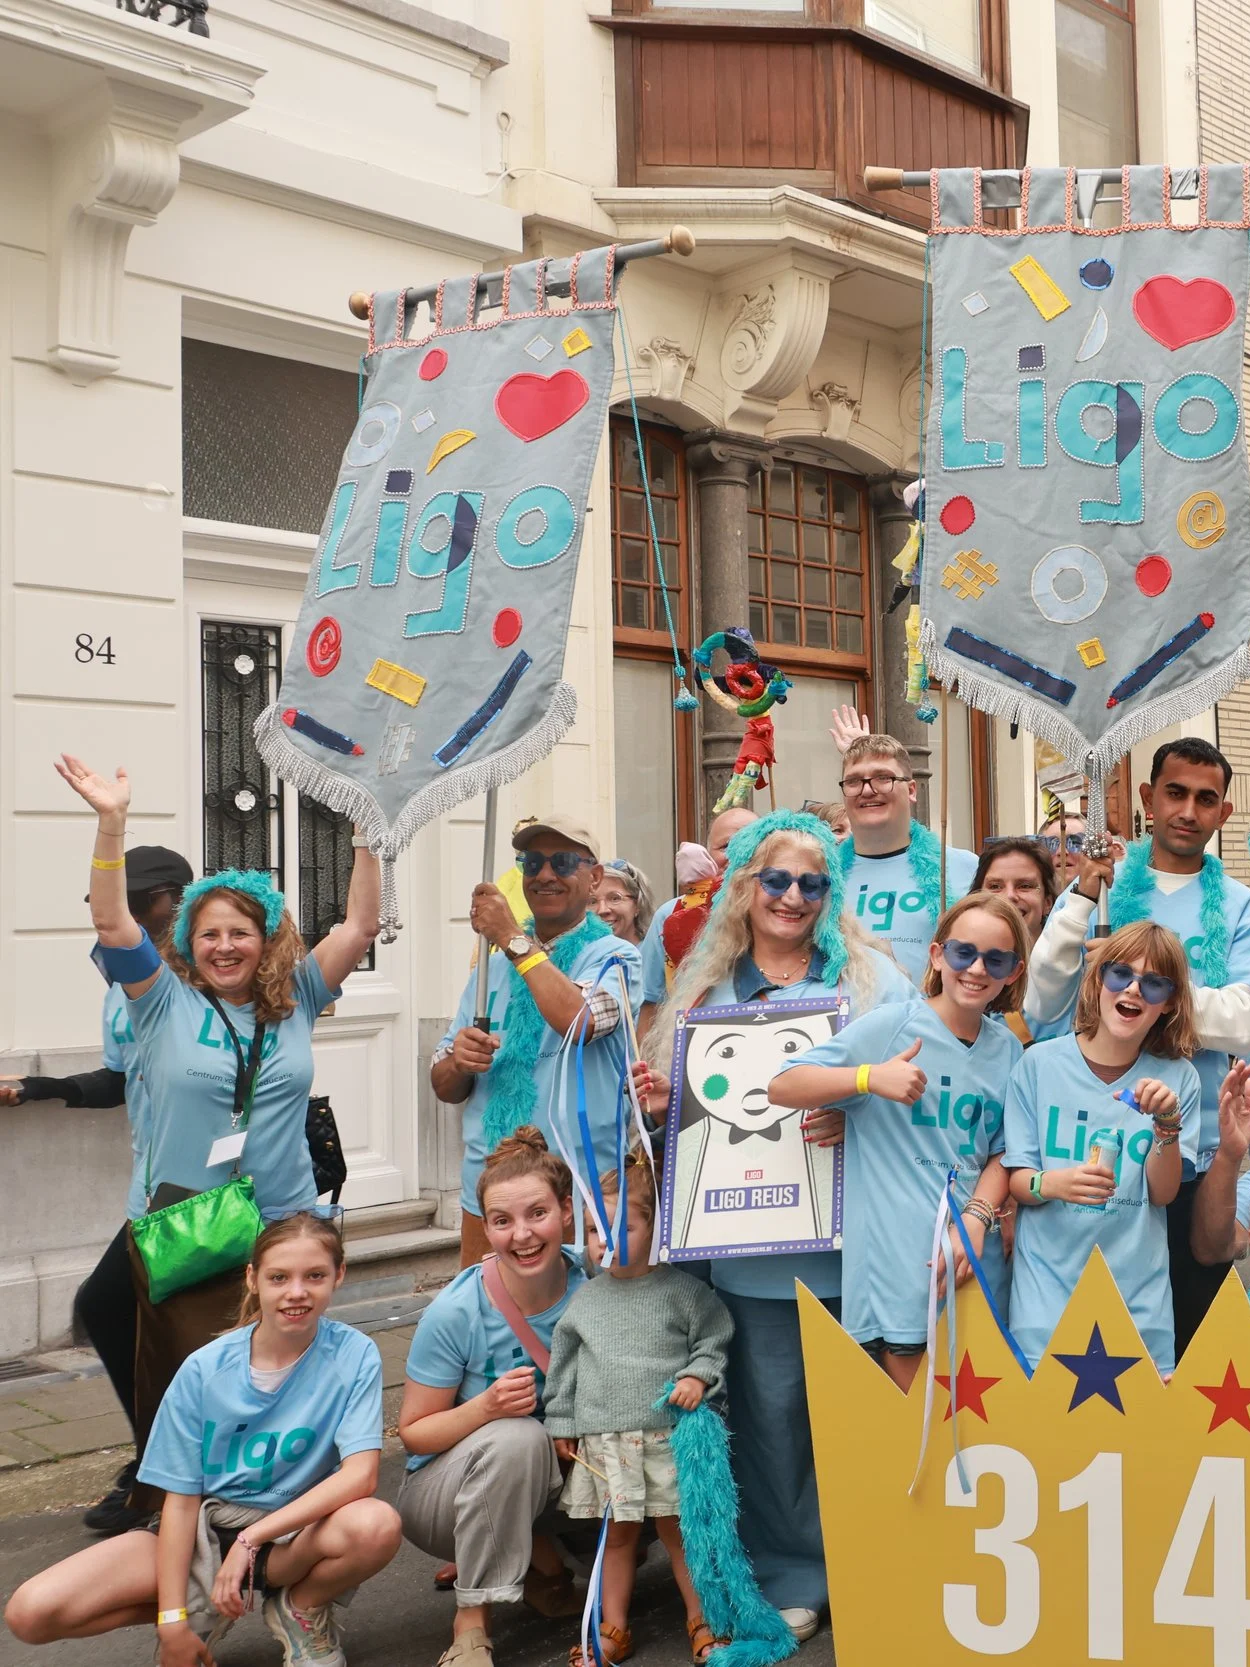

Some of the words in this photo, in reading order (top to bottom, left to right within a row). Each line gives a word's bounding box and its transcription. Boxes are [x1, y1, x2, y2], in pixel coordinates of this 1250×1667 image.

[937, 343, 1242, 526] Ligo
[314, 467, 578, 639] Ligo
[74, 633, 117, 666] 84
[856, 884, 929, 932] igo
[186, 1068, 223, 1082] Centrum
[911, 1075, 1004, 1156] Ligo
[710, 1190, 746, 1210] LIGO
[751, 1186, 794, 1207] REUS
[746, 1170, 762, 1180] LIGO
[200, 1420, 317, 1492] Ligo
